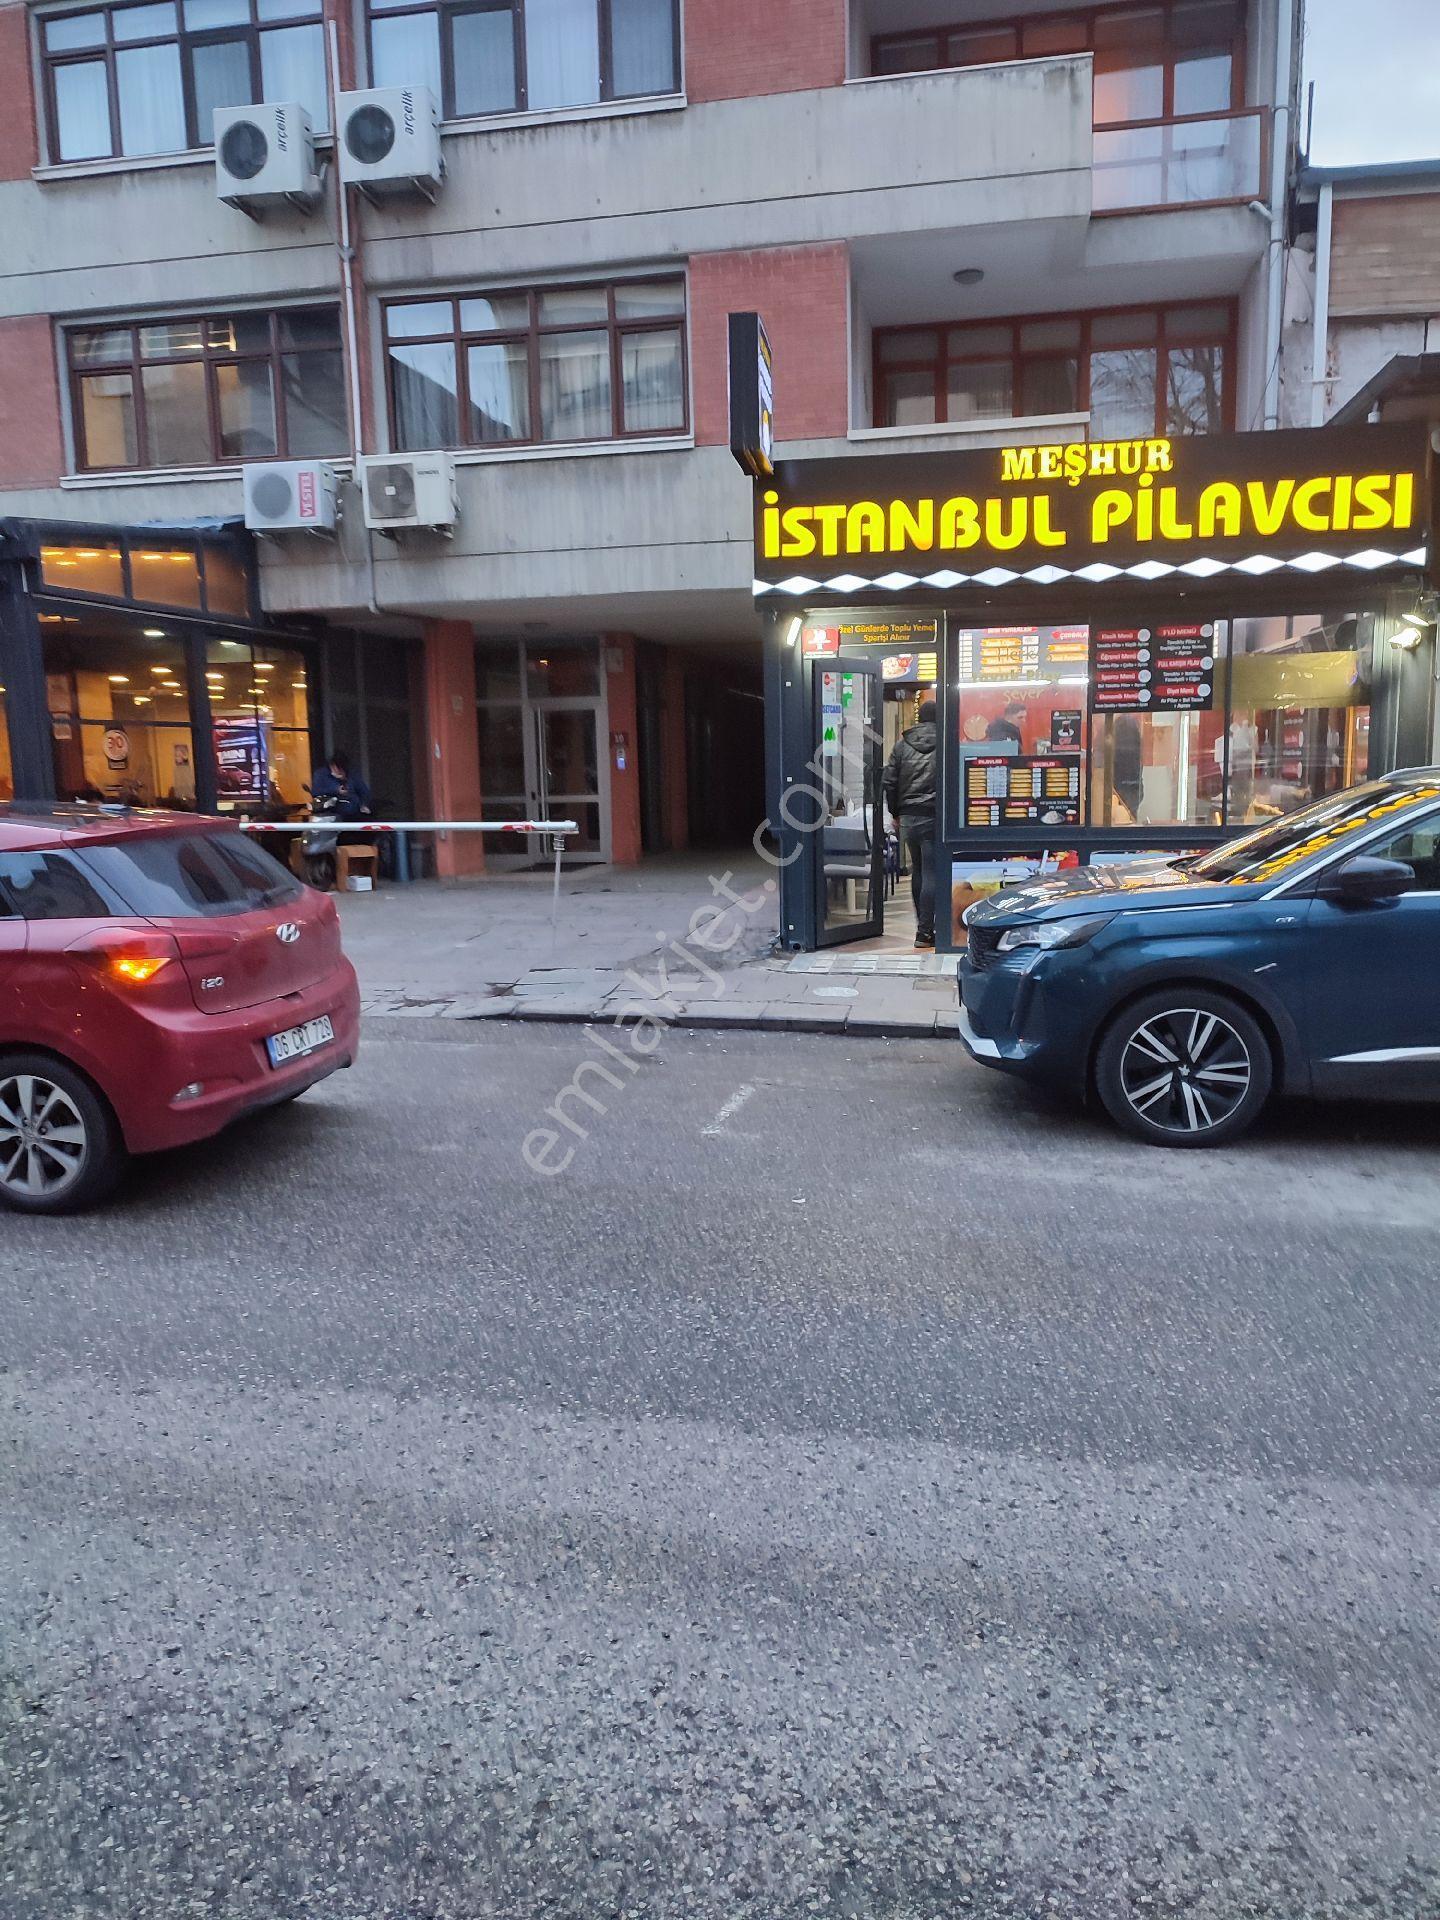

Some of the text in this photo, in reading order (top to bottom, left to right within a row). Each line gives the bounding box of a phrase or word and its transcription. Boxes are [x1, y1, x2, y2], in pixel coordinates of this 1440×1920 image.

[275, 107, 288, 152] arçelik
[401, 90, 414, 135] arçelik
[1001, 439, 1174, 486] MEŞHUR
[300, 473, 315, 516] VESTEL
[763, 473, 1413, 559] İSTANBUL PİLAVCISI
[855, 623, 889, 633] Günlerde
[890, 623, 912, 632] Toplu
[201, 976, 225, 990] i20
[274, 1034, 290, 1058] 06
